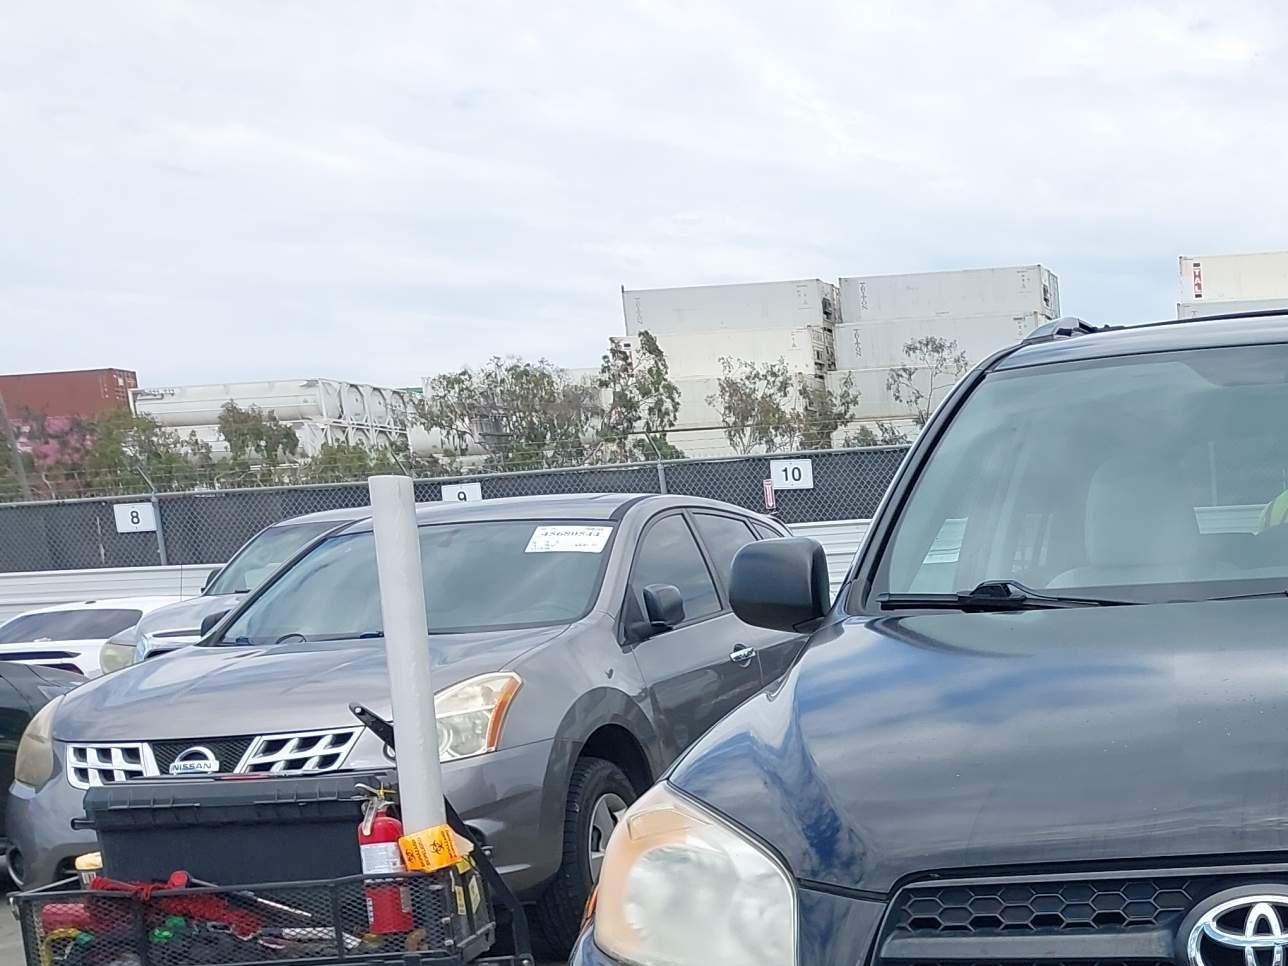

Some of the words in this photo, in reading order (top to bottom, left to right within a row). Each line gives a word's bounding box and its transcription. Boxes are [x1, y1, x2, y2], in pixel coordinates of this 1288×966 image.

[781, 466, 802, 482] 10
[130, 510, 140, 525] 8
[173, 762, 212, 771] NISSAN
